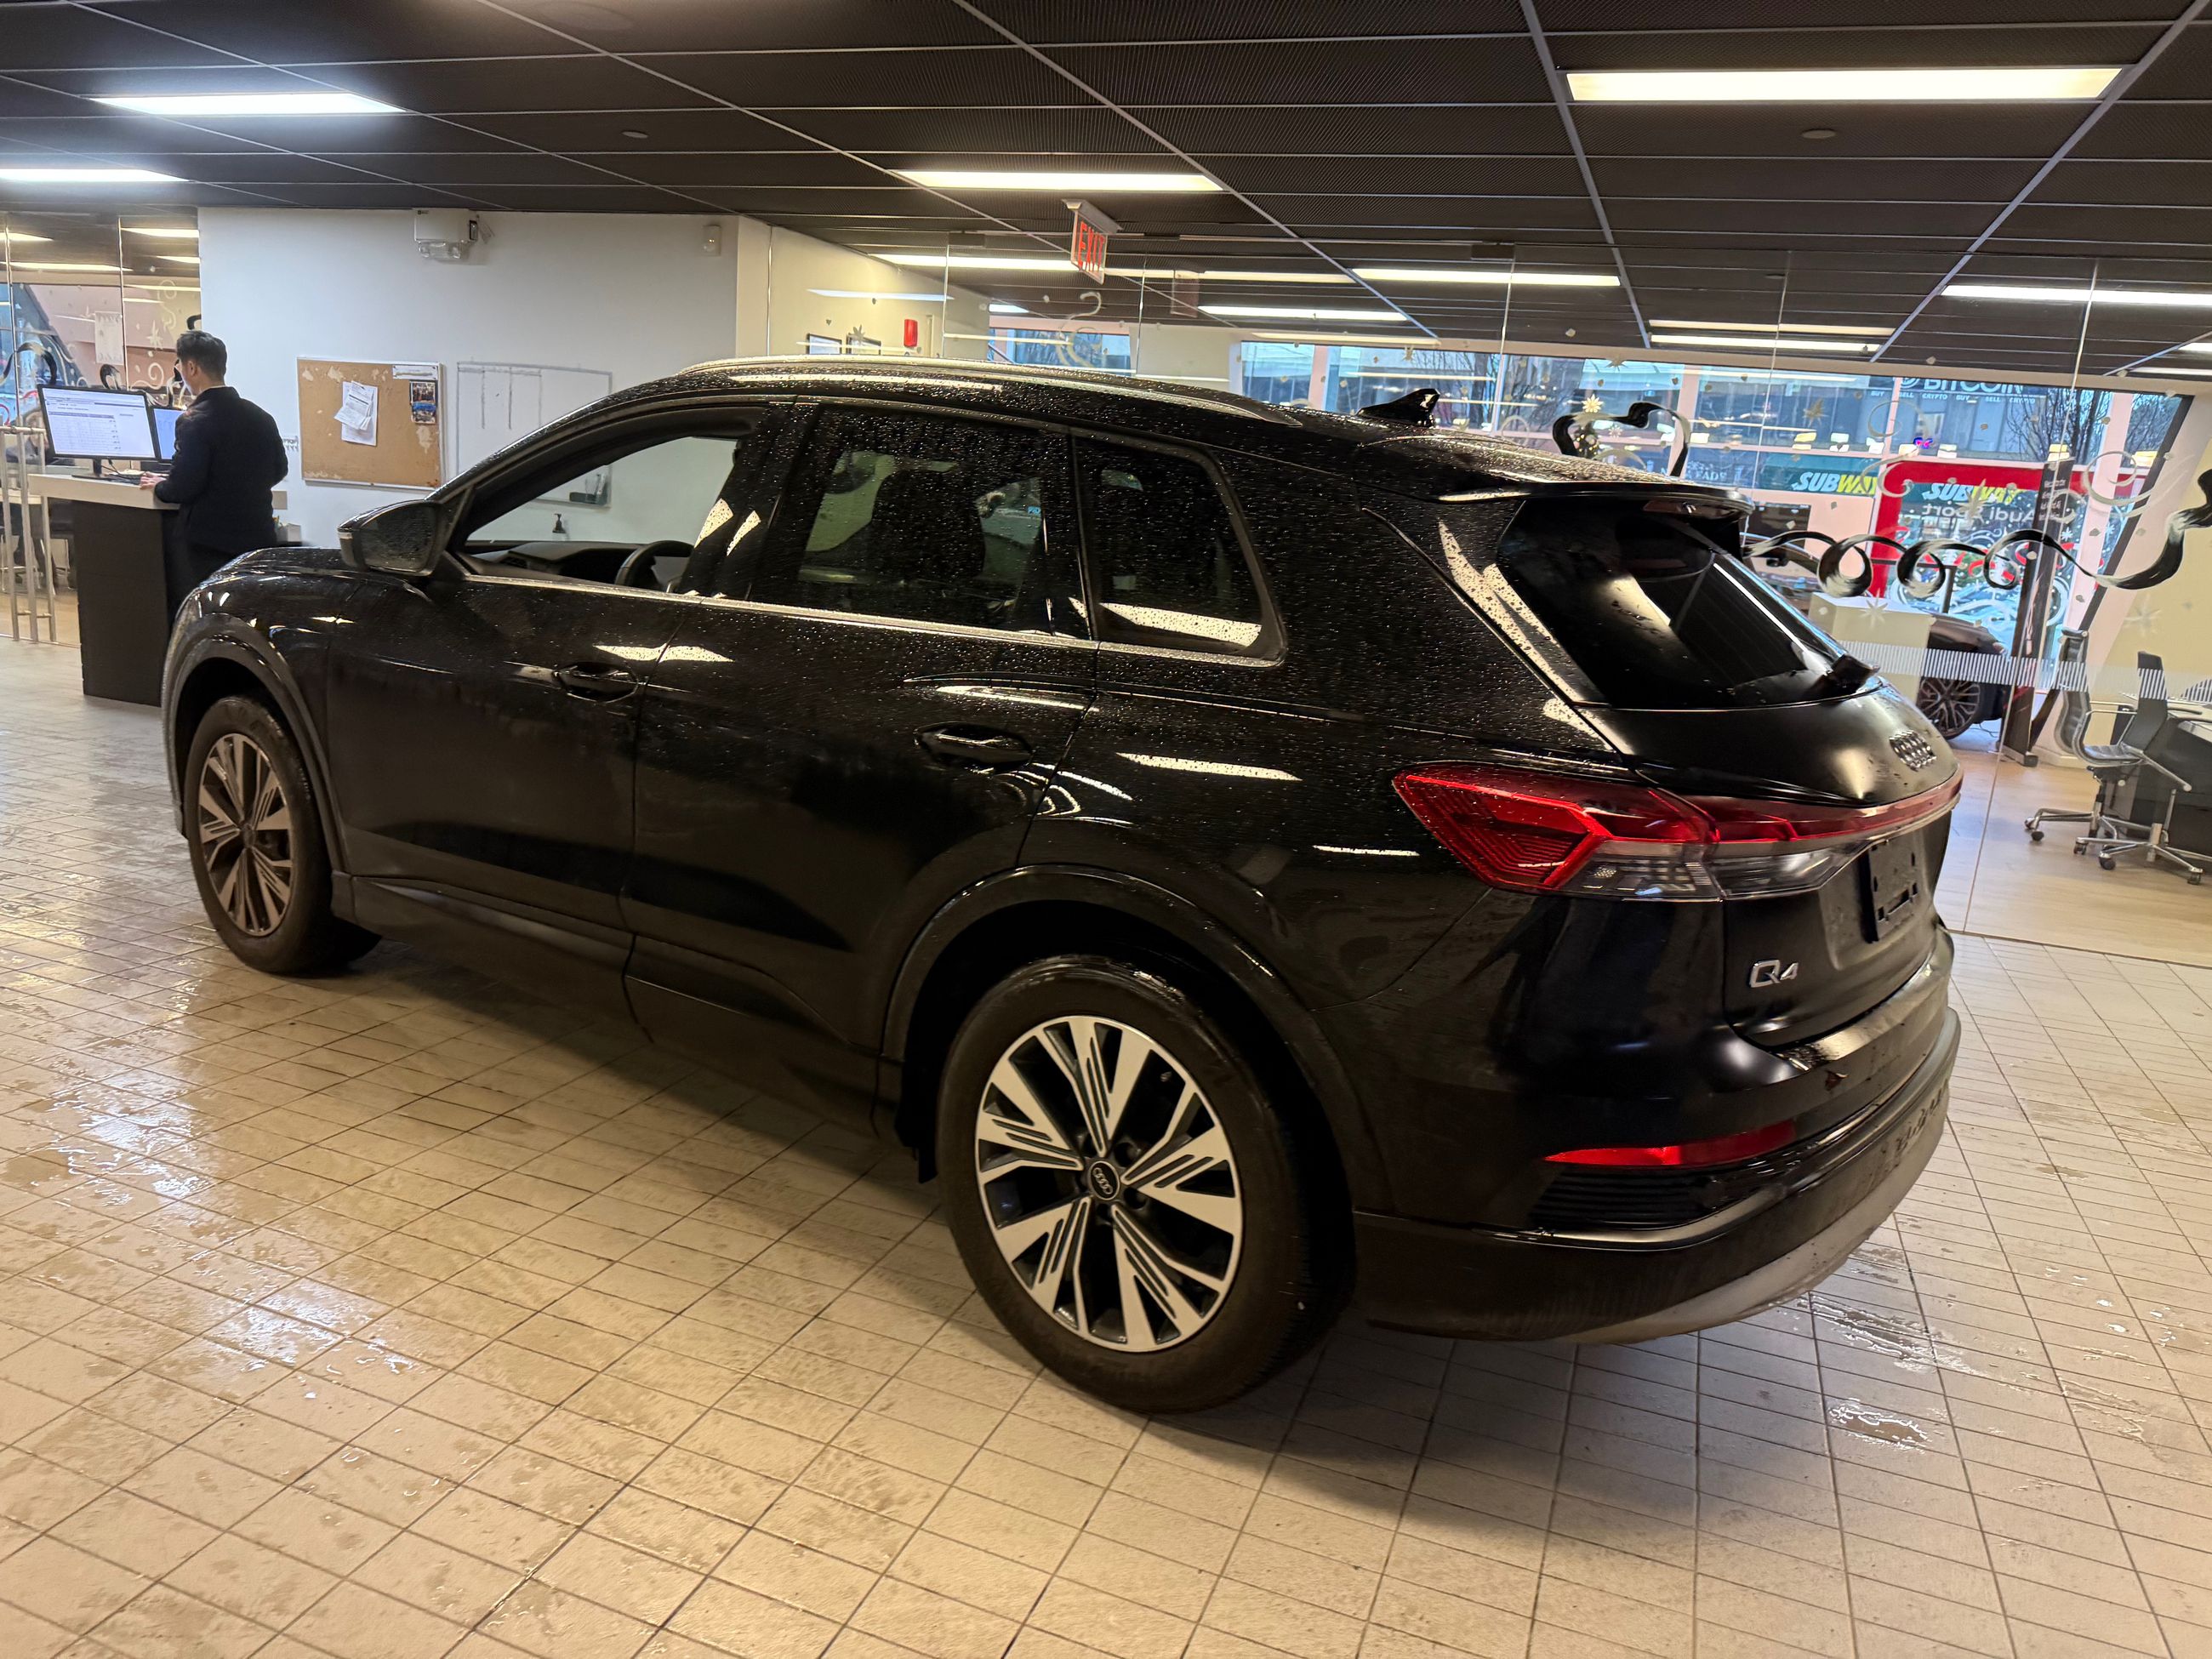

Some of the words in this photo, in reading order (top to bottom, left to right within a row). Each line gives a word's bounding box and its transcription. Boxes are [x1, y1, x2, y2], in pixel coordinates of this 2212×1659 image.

[1078, 221, 1106, 271] EXIT
[1922, 482, 2030, 505] SUBWAY
[1749, 960, 1799, 988] Q4
